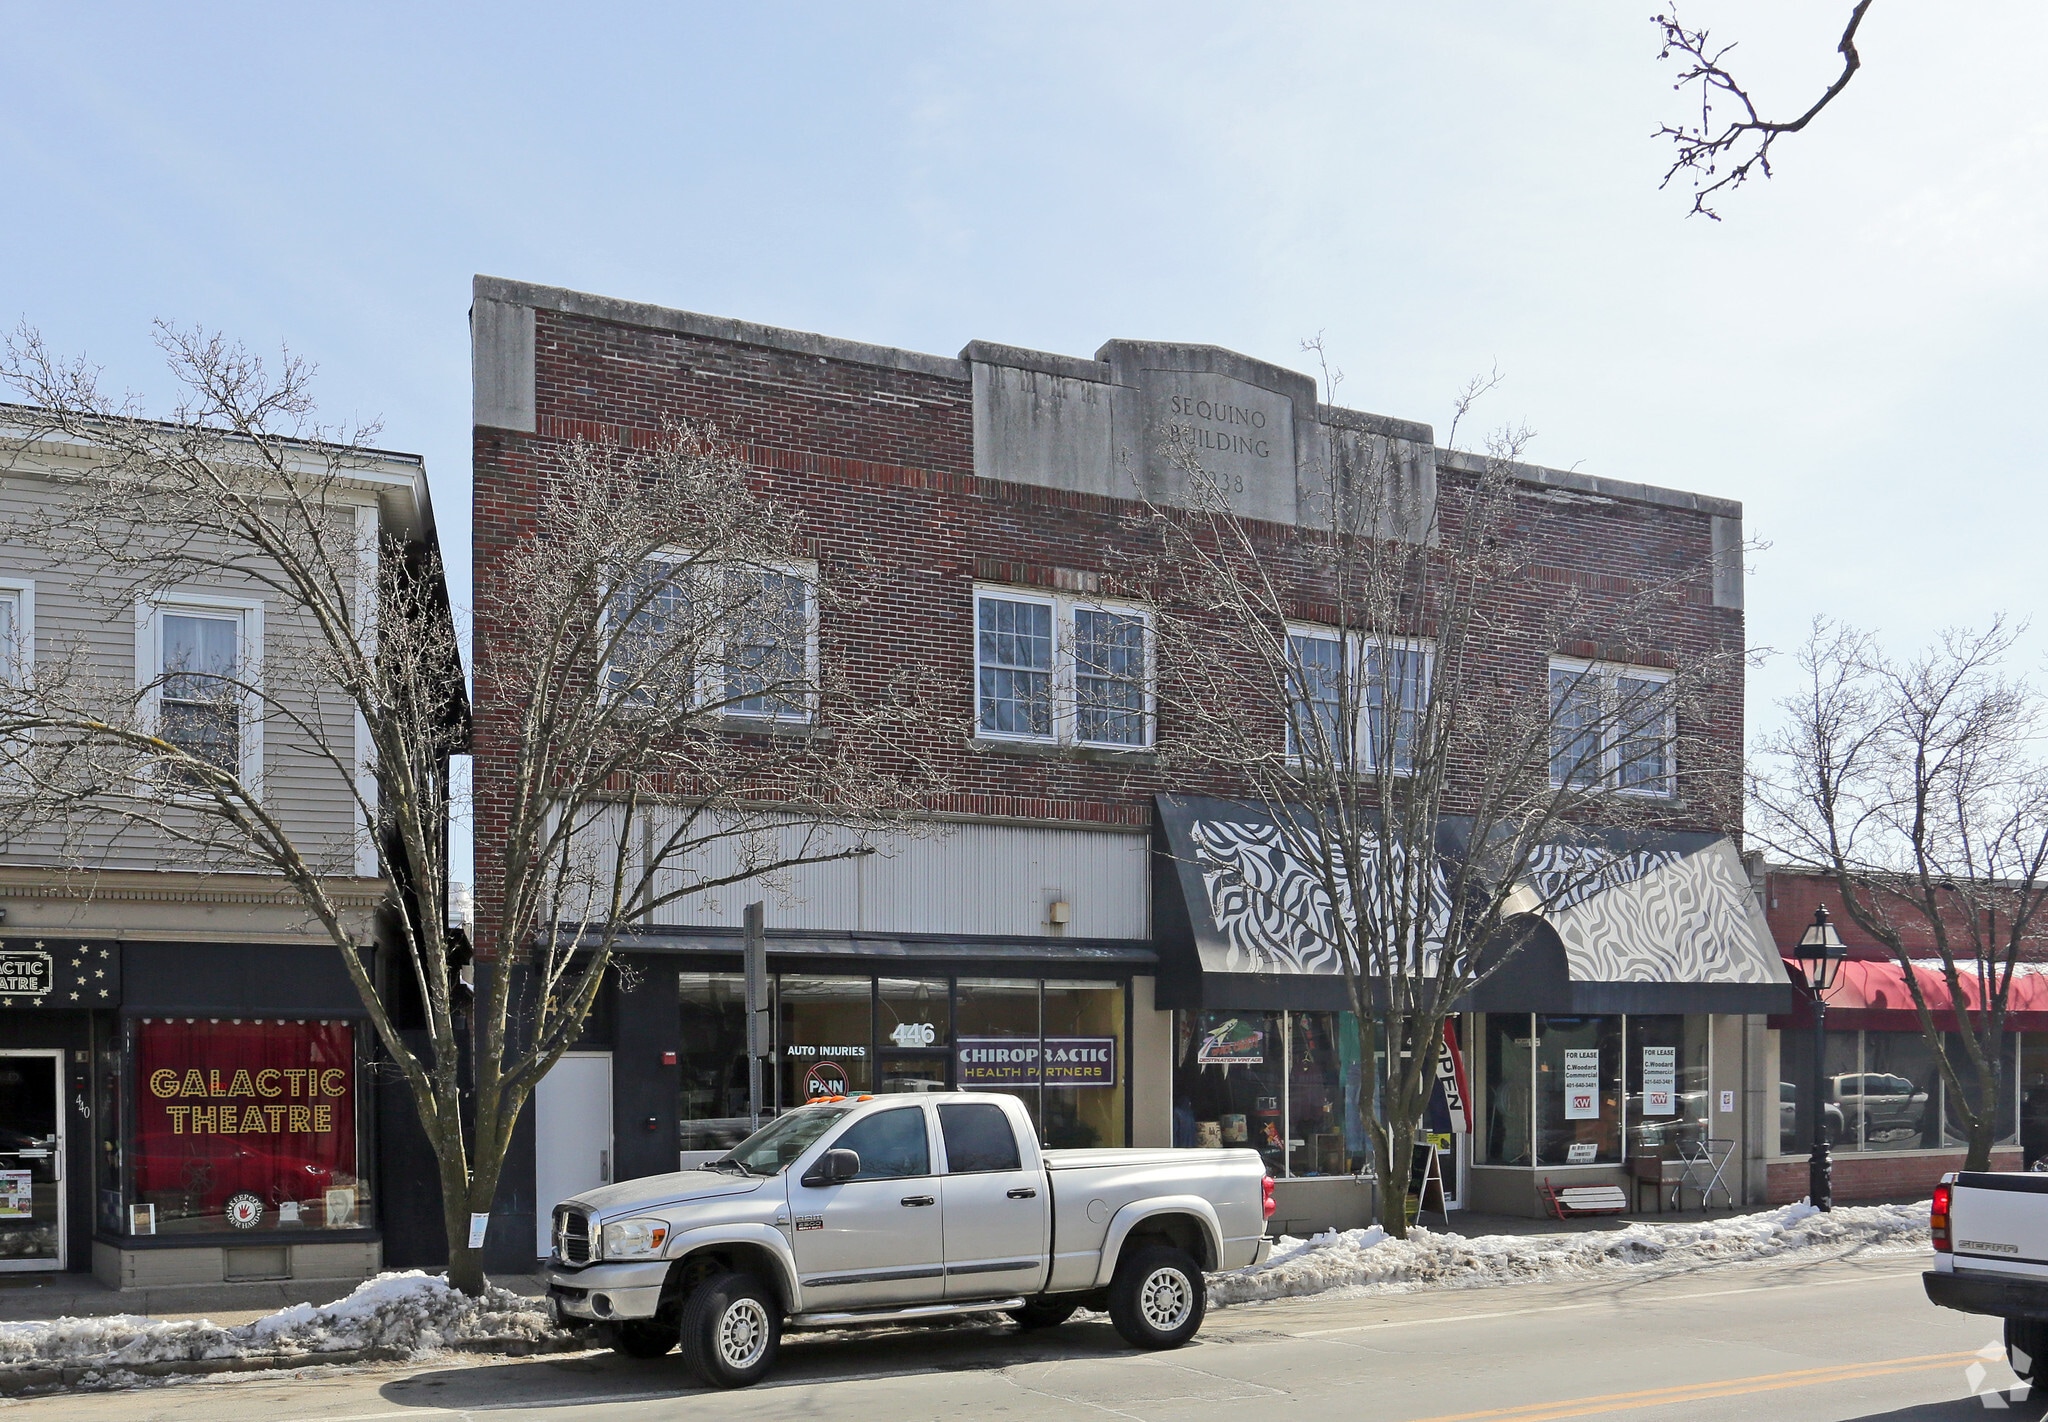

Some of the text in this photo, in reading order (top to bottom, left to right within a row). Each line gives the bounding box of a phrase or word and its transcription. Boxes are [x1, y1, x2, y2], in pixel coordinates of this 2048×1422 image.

[1171, 396, 1266, 429] SEQUINO
[1171, 424, 1270, 458] BUILDING
[0, 961, 44, 975] CTIC
[893, 1023, 935, 1043] 446
[787, 1046, 865, 1056] AUTO INJURIES
[960, 1048, 1108, 1063] CHIROPRACTIC
[965, 1068, 1021, 1077] HEALTH
[1438, 1041, 1462, 1110] OPEN
[150, 1068, 346, 1098] GALACTIC
[809, 1080, 843, 1093] PAIN
[75, 1094, 90, 1118] 440
[1573, 1097, 1590, 1108] KW
[1651, 1095, 1668, 1104] KW
[166, 1105, 332, 1134] THEATRE
[229, 1194, 249, 1207] KEEP
[226, 1210, 260, 1229] POUR HARD
[1958, 1240, 2018, 1254] SIERRA
